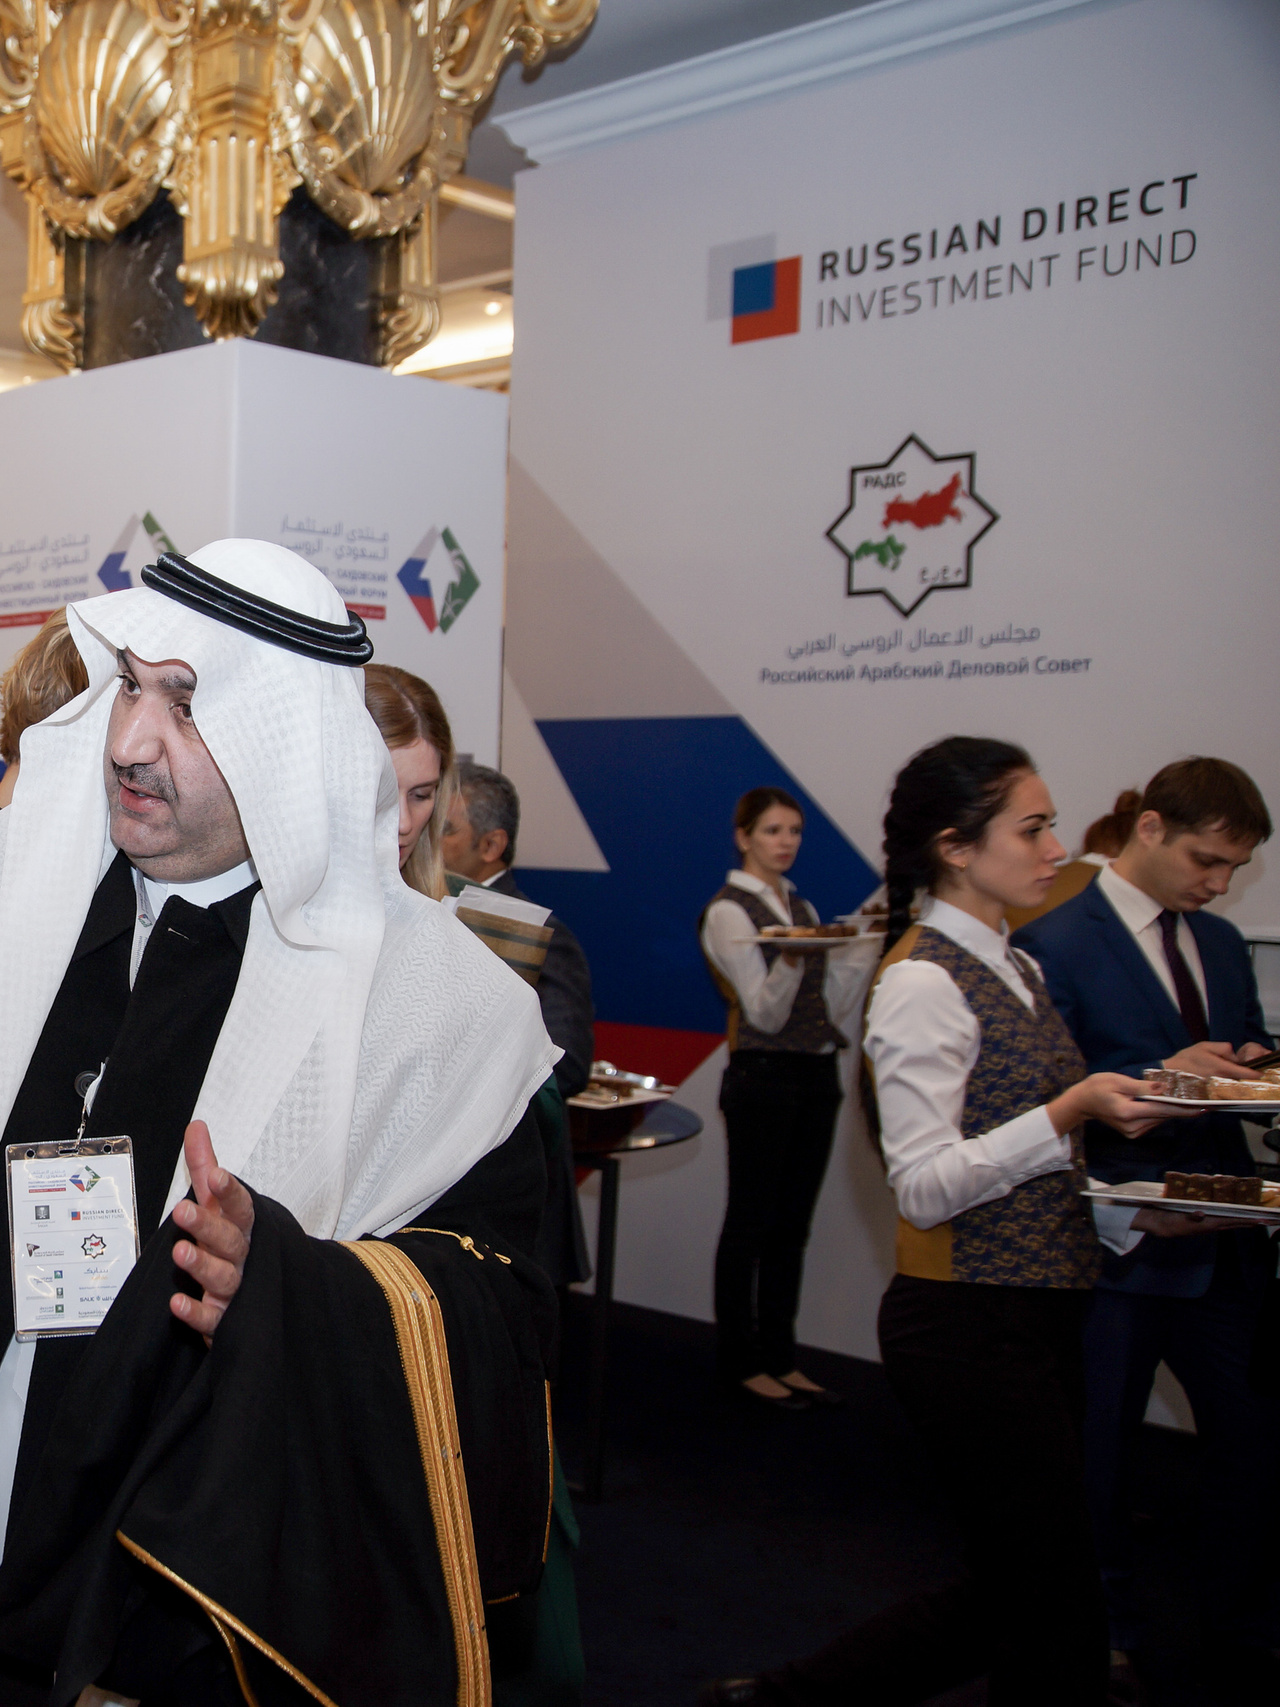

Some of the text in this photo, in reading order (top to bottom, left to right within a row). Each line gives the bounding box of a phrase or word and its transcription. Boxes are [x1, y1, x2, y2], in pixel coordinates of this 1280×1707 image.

[818, 172, 1198, 283] RUSSIAN DIRECT
[816, 229, 1198, 329] INVESTMENT FUND
[863, 472, 906, 489] РАДС
[979, 623, 1041, 649] مجلس
[759, 655, 1093, 685] Российский Арабский Деловой Совет
